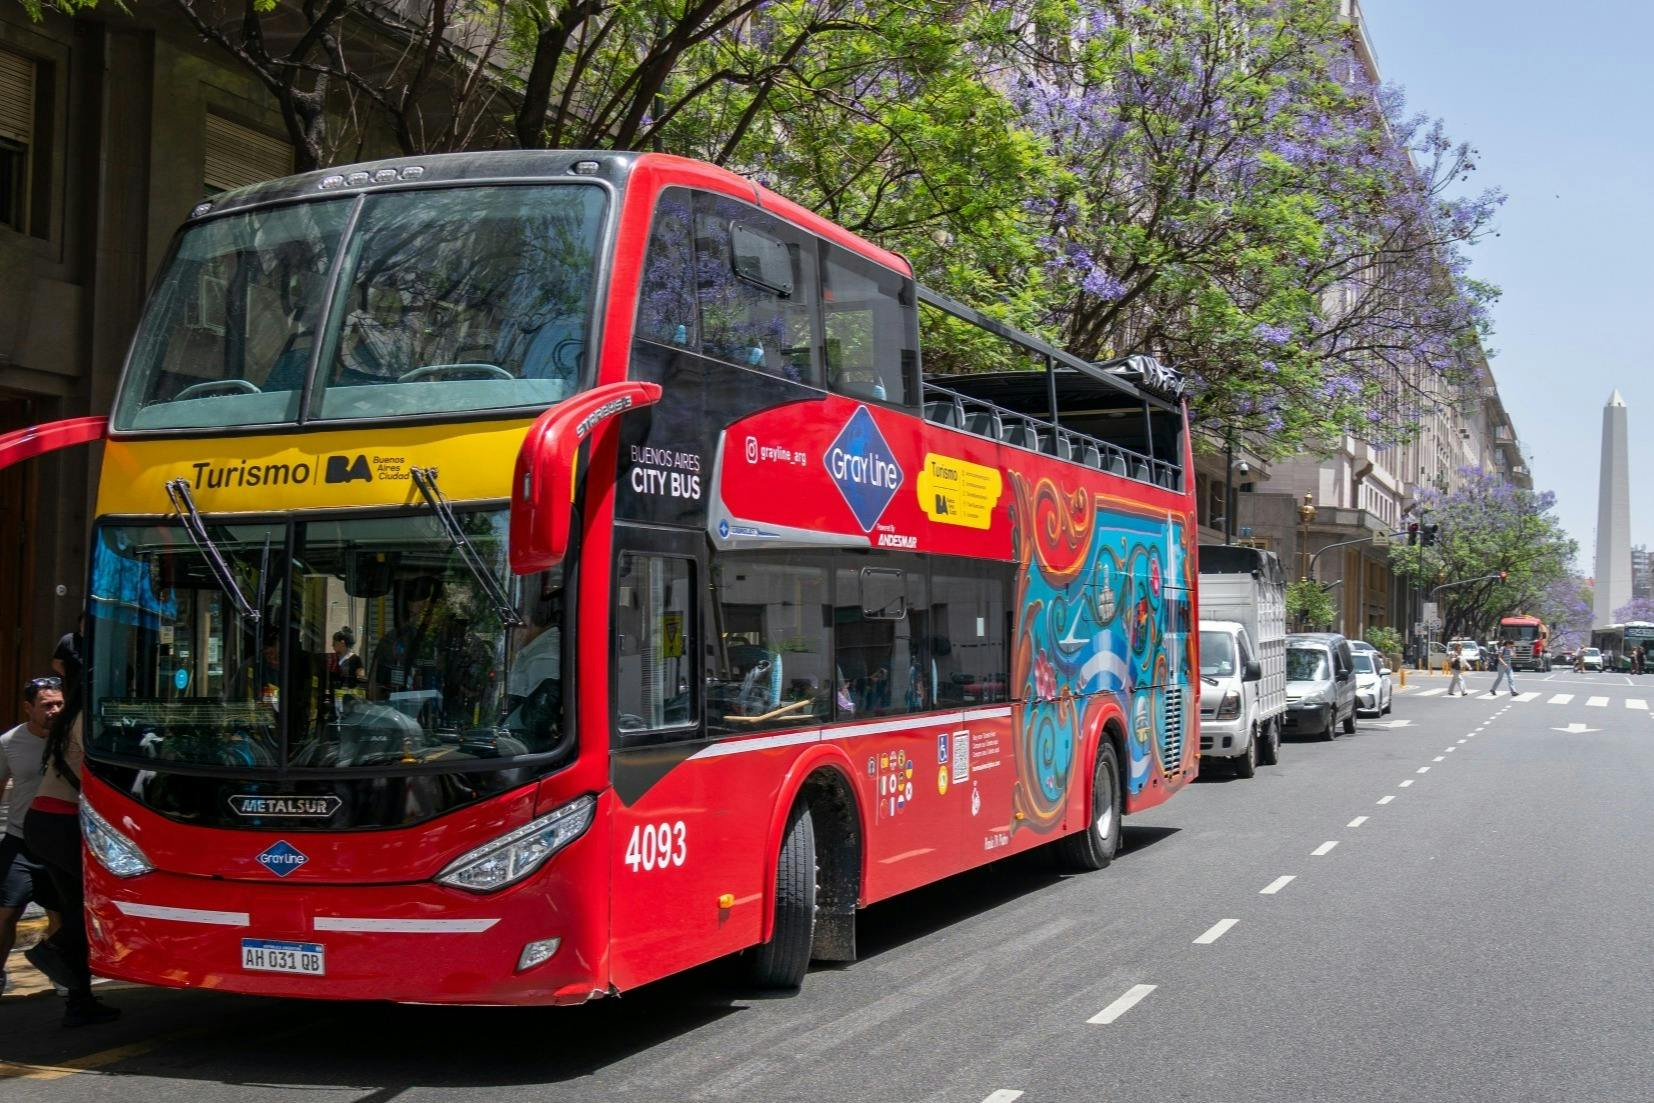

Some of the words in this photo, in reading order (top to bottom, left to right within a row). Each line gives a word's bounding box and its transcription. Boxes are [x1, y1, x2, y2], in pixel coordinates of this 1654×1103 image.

[373, 456, 405, 464] Buenos
[631, 445, 673, 467] BUENOS
[674, 452, 700, 471] AIRES
[760, 446, 807, 467] grayline_arg
[192, 459, 310, 490] Turismo
[325, 454, 373, 484] BA
[377, 464, 401, 472] Aires
[378, 472, 410, 480] Ciudad
[931, 461, 959, 481] Turismo
[631, 467, 668, 495] CITY
[671, 473, 701, 500] BUS
[935, 494, 949, 516] BA
[877, 533, 918, 549] ANDESMAR
[241, 800, 328, 814] METALSUR
[625, 820, 687, 873] 4093
[246, 949, 264, 967] AH
[269, 951, 297, 970] 031
[301, 953, 320, 971] QB
